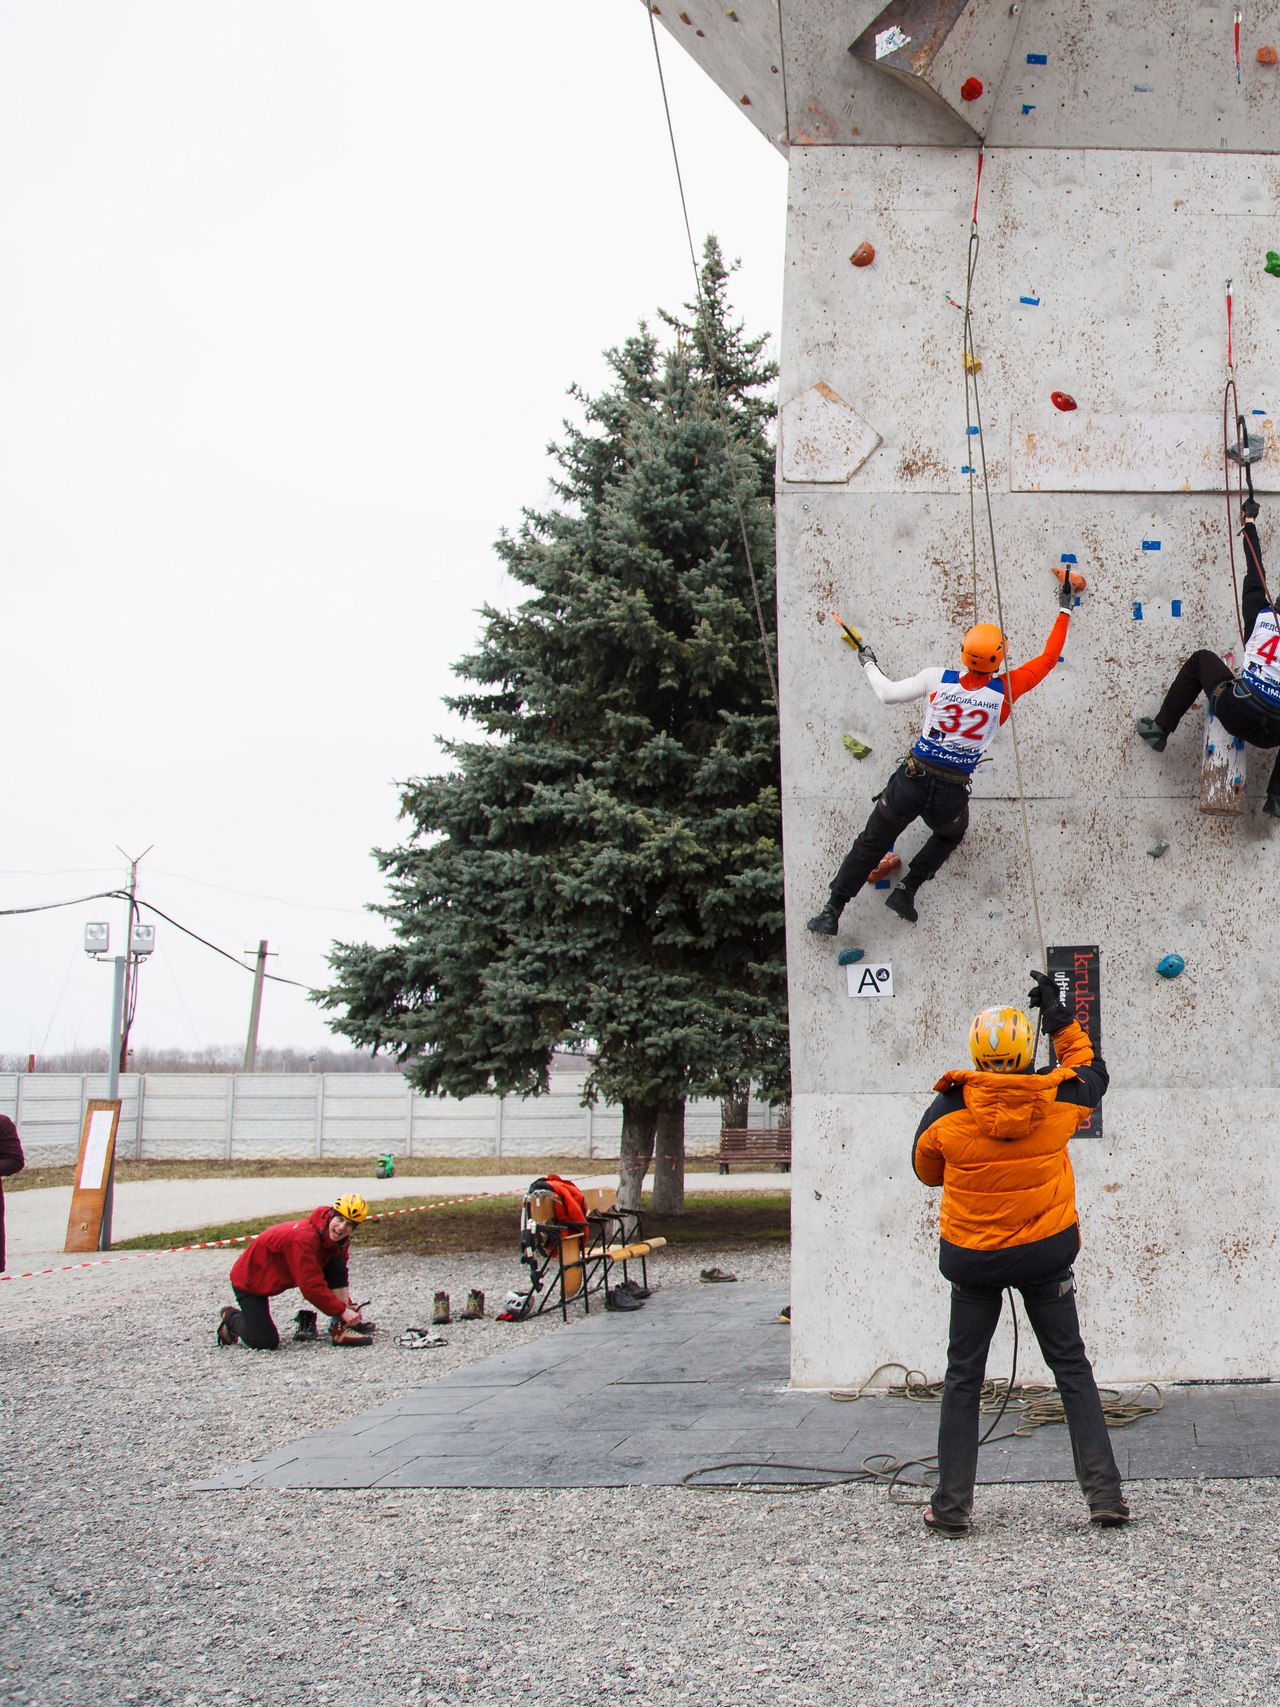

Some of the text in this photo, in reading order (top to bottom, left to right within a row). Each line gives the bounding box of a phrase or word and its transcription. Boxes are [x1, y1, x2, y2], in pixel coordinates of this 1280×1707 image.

[941, 693, 999, 710] ЛЕДОЛАЗАНИЕ
[938, 704, 989, 740] 32
[858, 968, 880, 994] A
